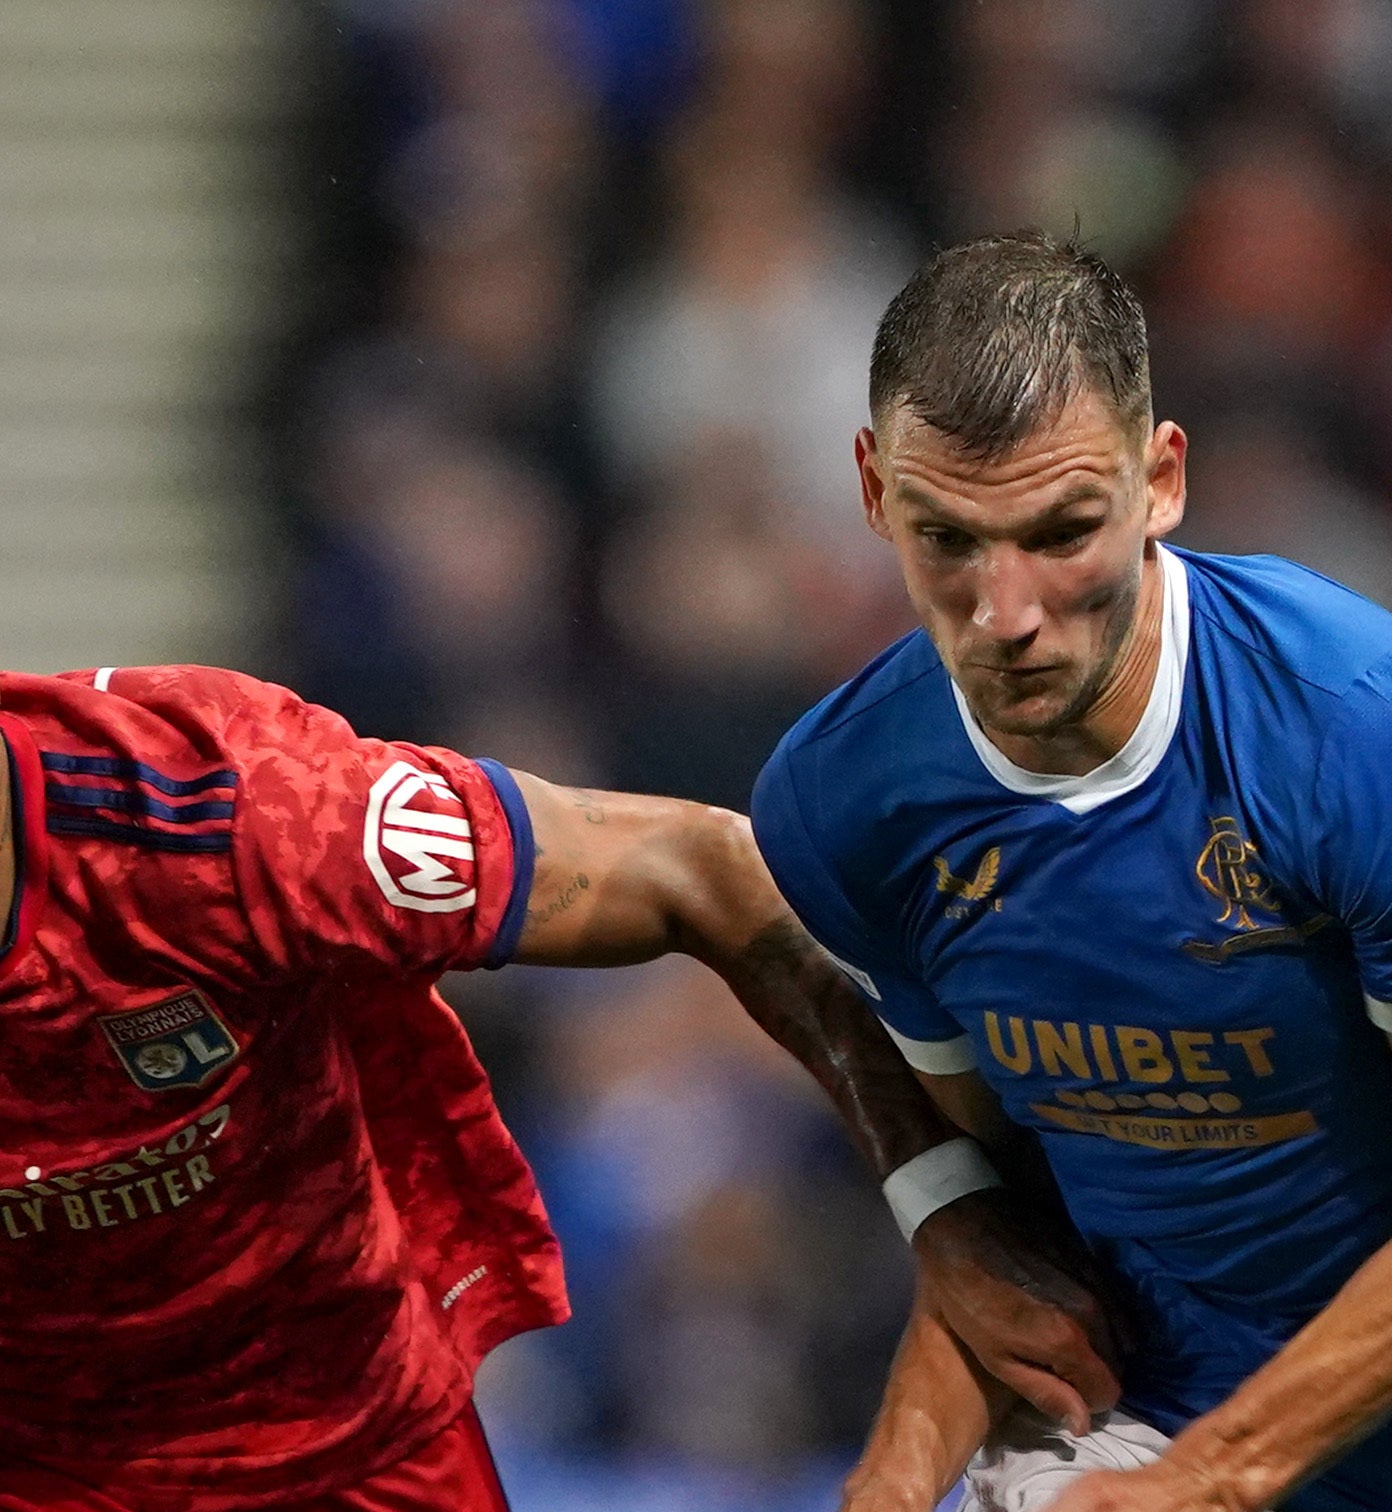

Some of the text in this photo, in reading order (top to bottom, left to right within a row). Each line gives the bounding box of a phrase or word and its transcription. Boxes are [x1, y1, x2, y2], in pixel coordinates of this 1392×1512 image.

[110, 998, 196, 1032] OLYMPIQUE
[116, 1007, 205, 1042] LYONNAIS
[983, 1009, 1276, 1084] UNIBET
[1182, 1124, 1259, 1143] LIMITS
[62, 1153, 216, 1231] BETTER
